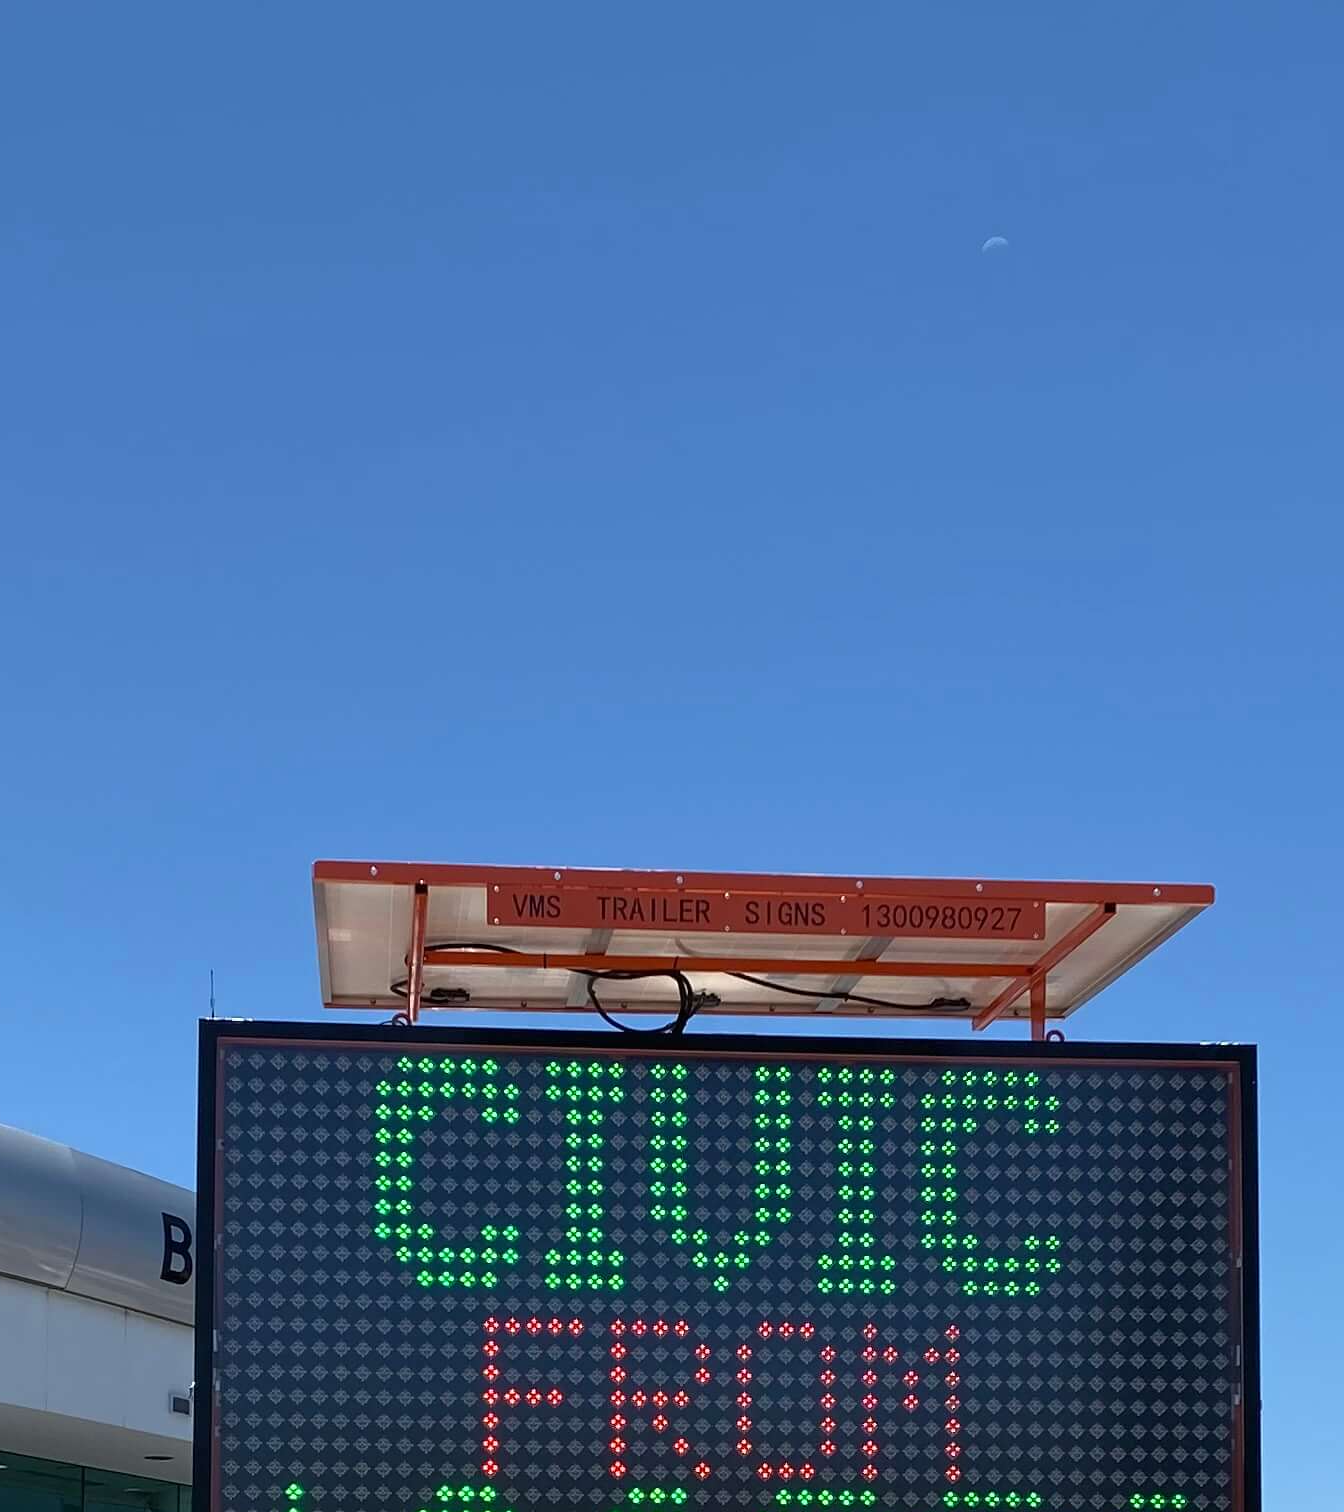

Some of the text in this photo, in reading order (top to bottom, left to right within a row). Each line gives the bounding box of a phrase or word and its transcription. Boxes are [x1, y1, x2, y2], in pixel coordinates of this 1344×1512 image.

[513, 895, 1022, 931] VMS TRAILER SIGNS 1300980927
[374, 1055, 1061, 1297] CIVIC
[481, 1315, 963, 1482] FROM
